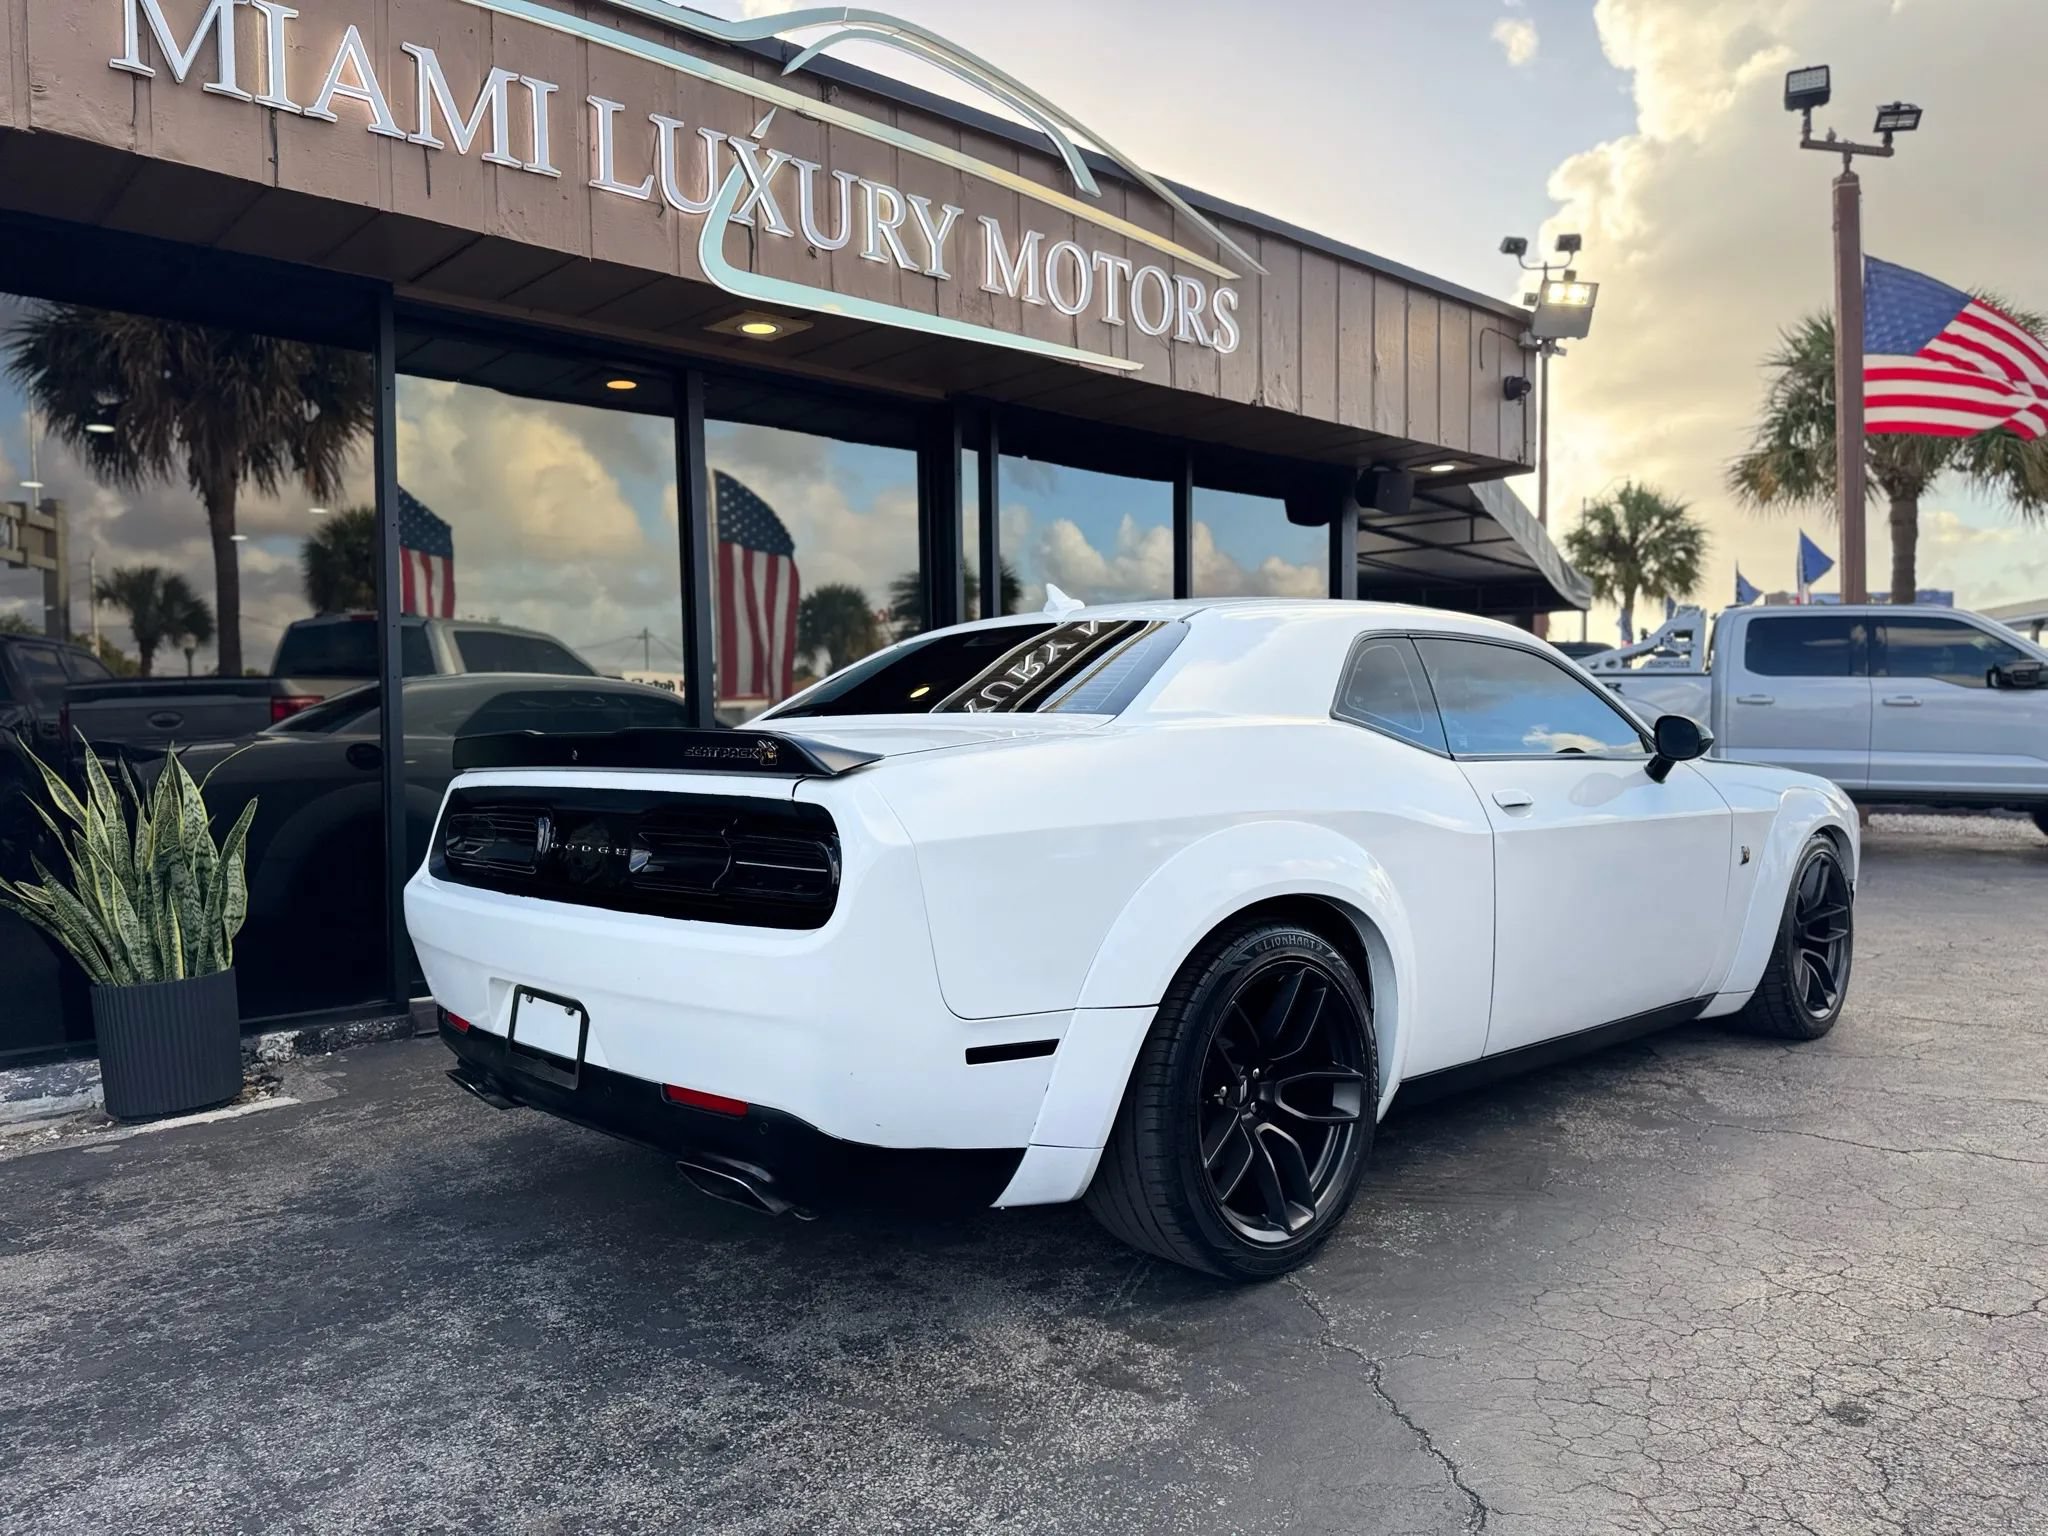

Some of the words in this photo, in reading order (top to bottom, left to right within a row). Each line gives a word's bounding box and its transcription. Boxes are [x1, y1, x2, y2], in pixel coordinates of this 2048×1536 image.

[109, 0, 562, 178] MIAMI
[586, 95, 964, 280] LUXURY
[978, 215, 1239, 353] MOTORS
[684, 746, 720, 758] SCAT
[720, 747, 760, 759] PACK
[550, 842, 629, 856] DODGE
